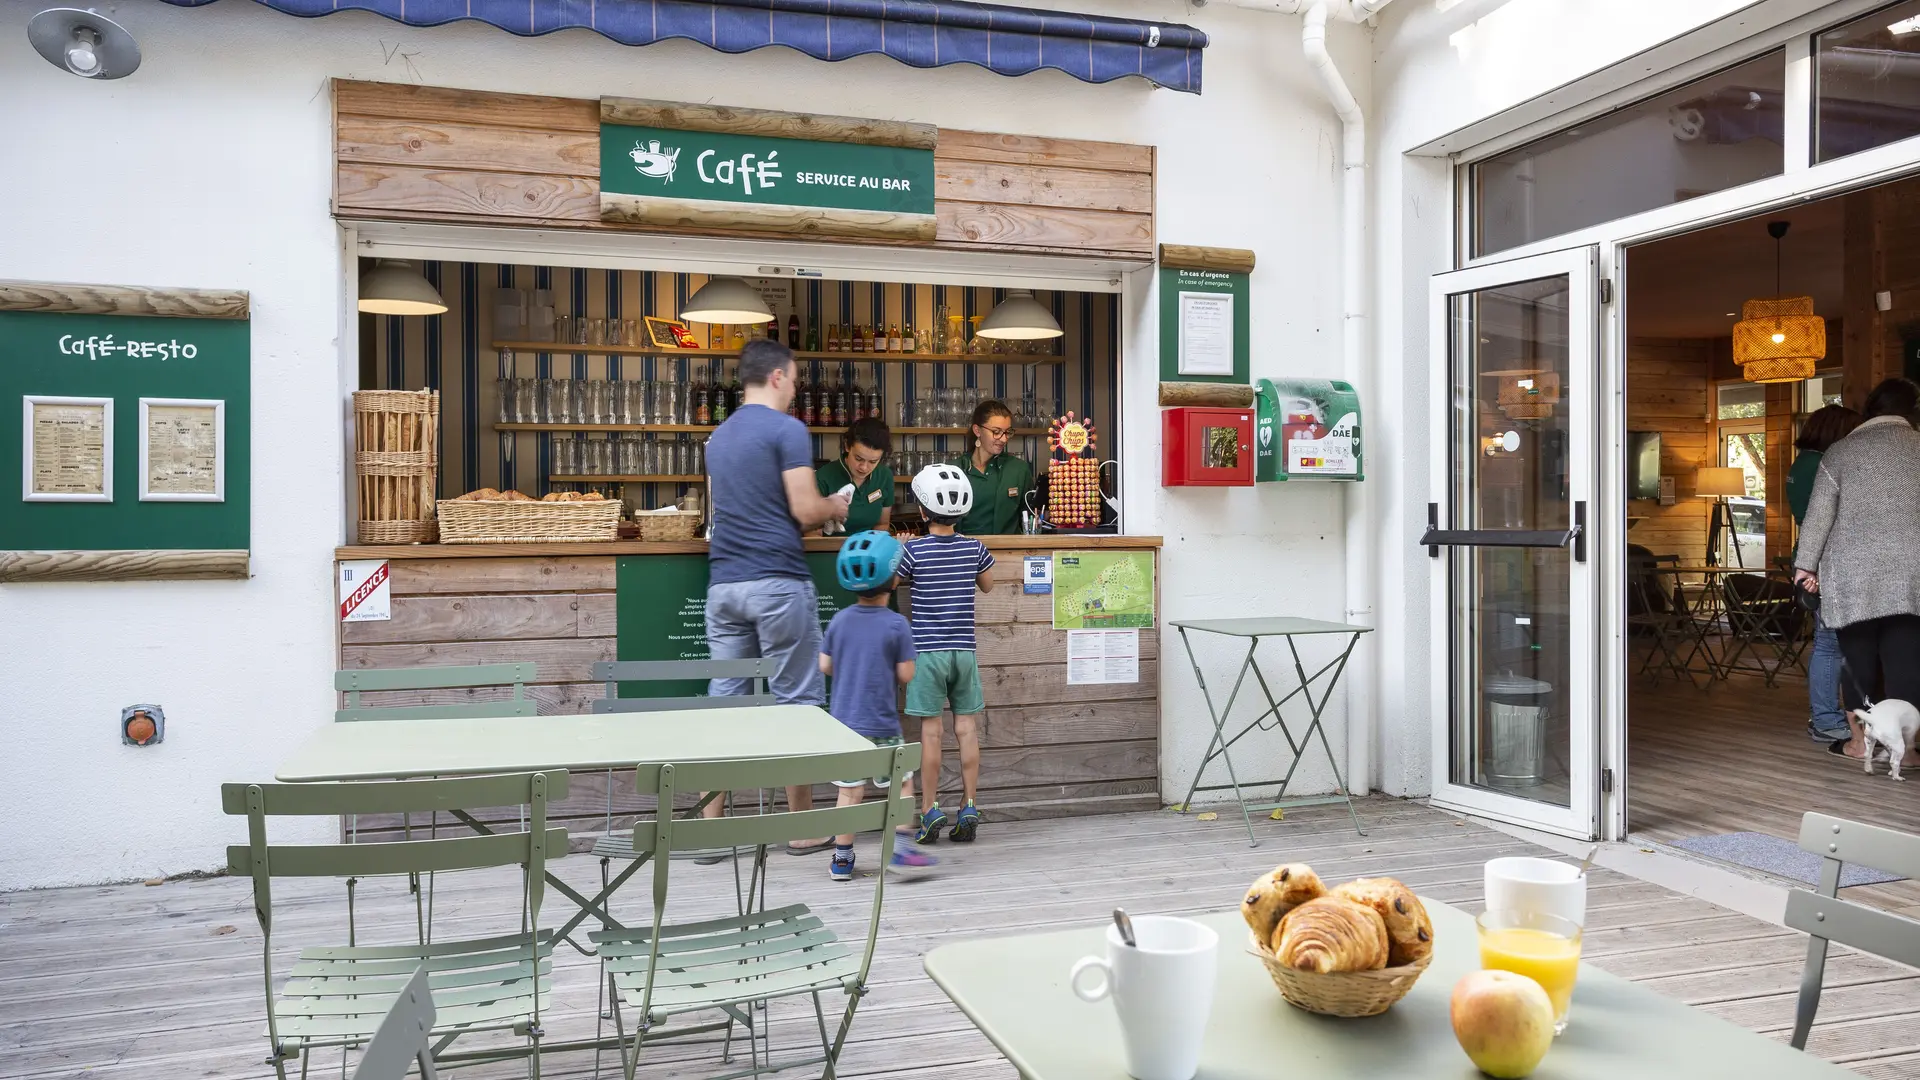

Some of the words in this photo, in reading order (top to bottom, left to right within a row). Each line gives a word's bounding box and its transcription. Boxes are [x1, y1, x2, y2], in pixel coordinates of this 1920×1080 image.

[796, 171, 856, 188] SERVICE
[859, 174, 879, 189] AU
[882, 177, 911, 191] BAR
[1205, 280, 1233, 288] emergency
[1064, 429, 1085, 439] Chupa
[1332, 429, 1351, 438] DAE
[1063, 437, 1085, 446] Chups
[1031, 566, 1045, 574] eps
[345, 567, 385, 613] LICENCE
